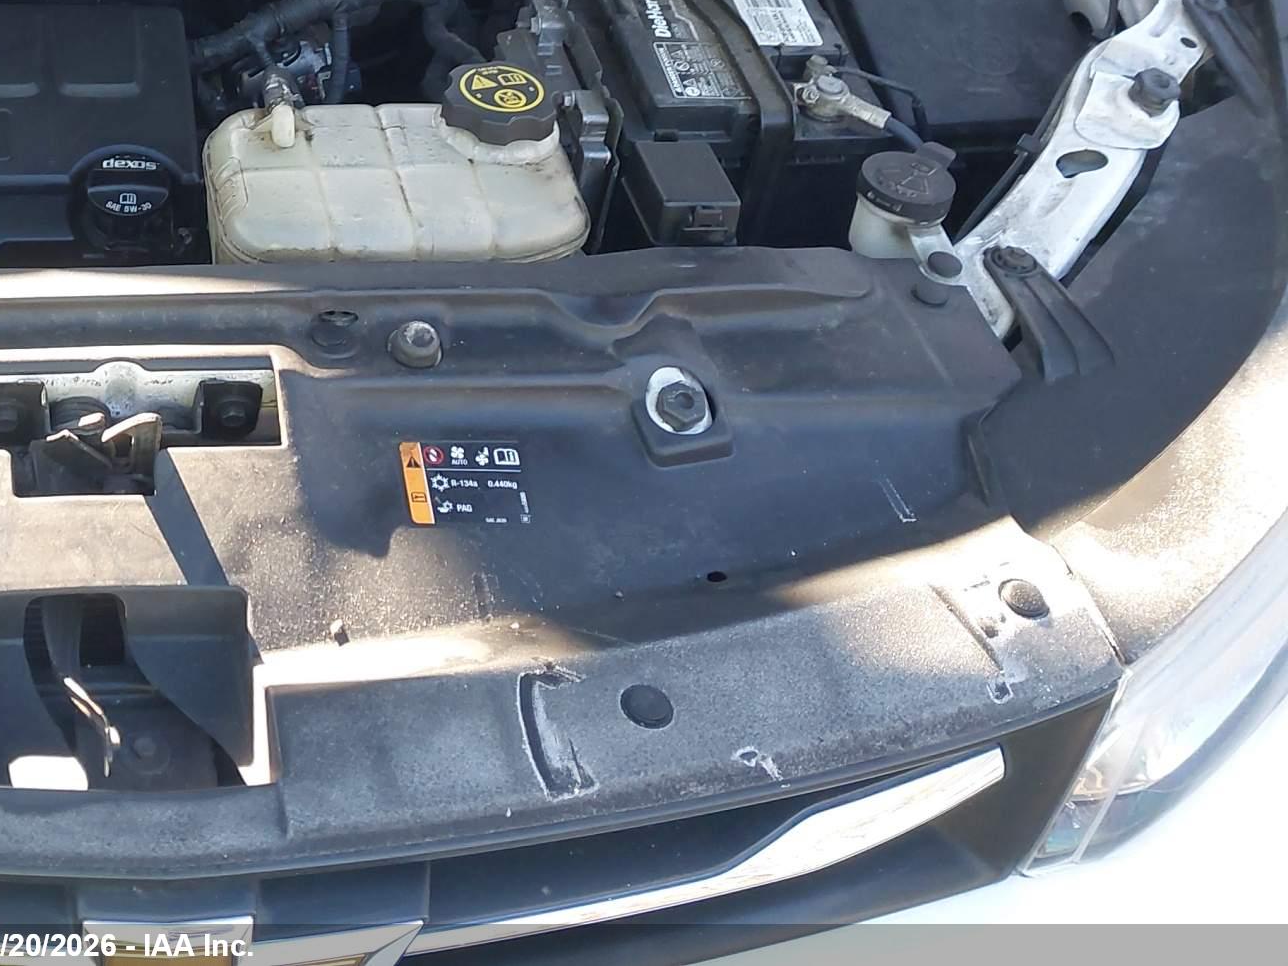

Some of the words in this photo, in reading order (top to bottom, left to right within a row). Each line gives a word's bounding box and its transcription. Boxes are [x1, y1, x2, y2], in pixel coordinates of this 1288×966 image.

[102, 157, 157, 171] dexos
[105, 200, 122, 212] SAE
[451, 458, 468, 466] AUTO
[456, 503, 473, 513] PAG
